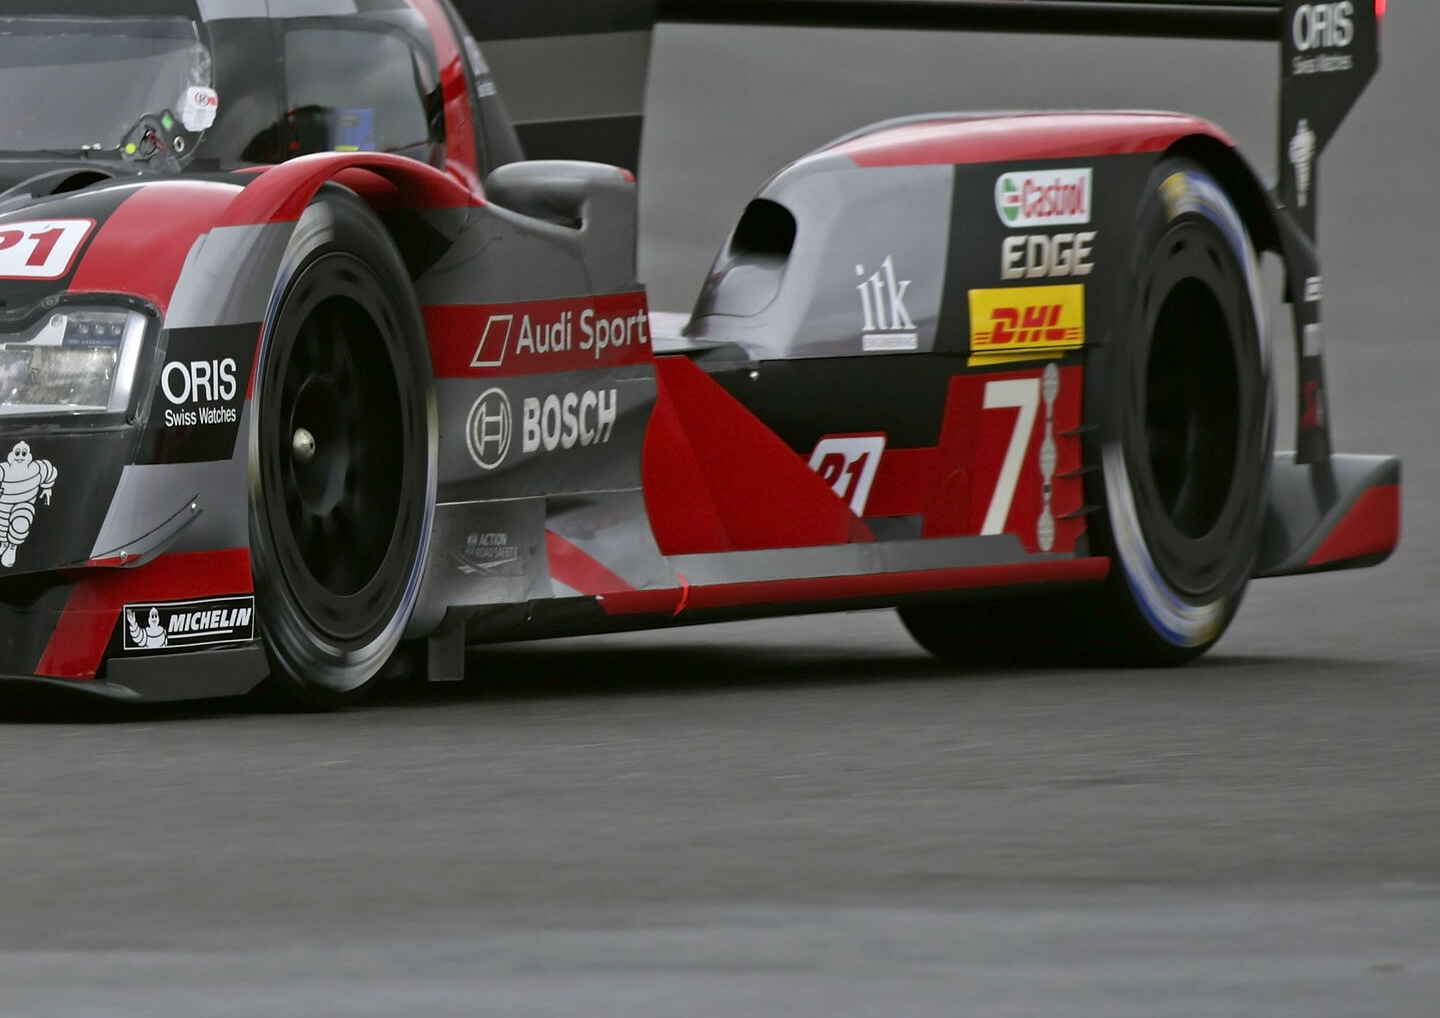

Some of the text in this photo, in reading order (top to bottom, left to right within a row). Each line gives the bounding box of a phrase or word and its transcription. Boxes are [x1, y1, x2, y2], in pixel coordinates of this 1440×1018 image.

[1292, 0, 1354, 51] ORIS
[1022, 176, 1087, 219] Castrol
[1001, 231, 1098, 280] EDGE
[855, 254, 918, 331] itk
[516, 309, 647, 360] Audi Sport
[990, 304, 1067, 344] DHL
[161, 358, 237, 404] ORIS
[165, 406, 237, 427] Swiss Watches
[522, 389, 617, 453] BOSCH
[980, 378, 1041, 536] 7
[479, 533, 507, 546] ACTION
[168, 607, 252, 632] MICHELIN
